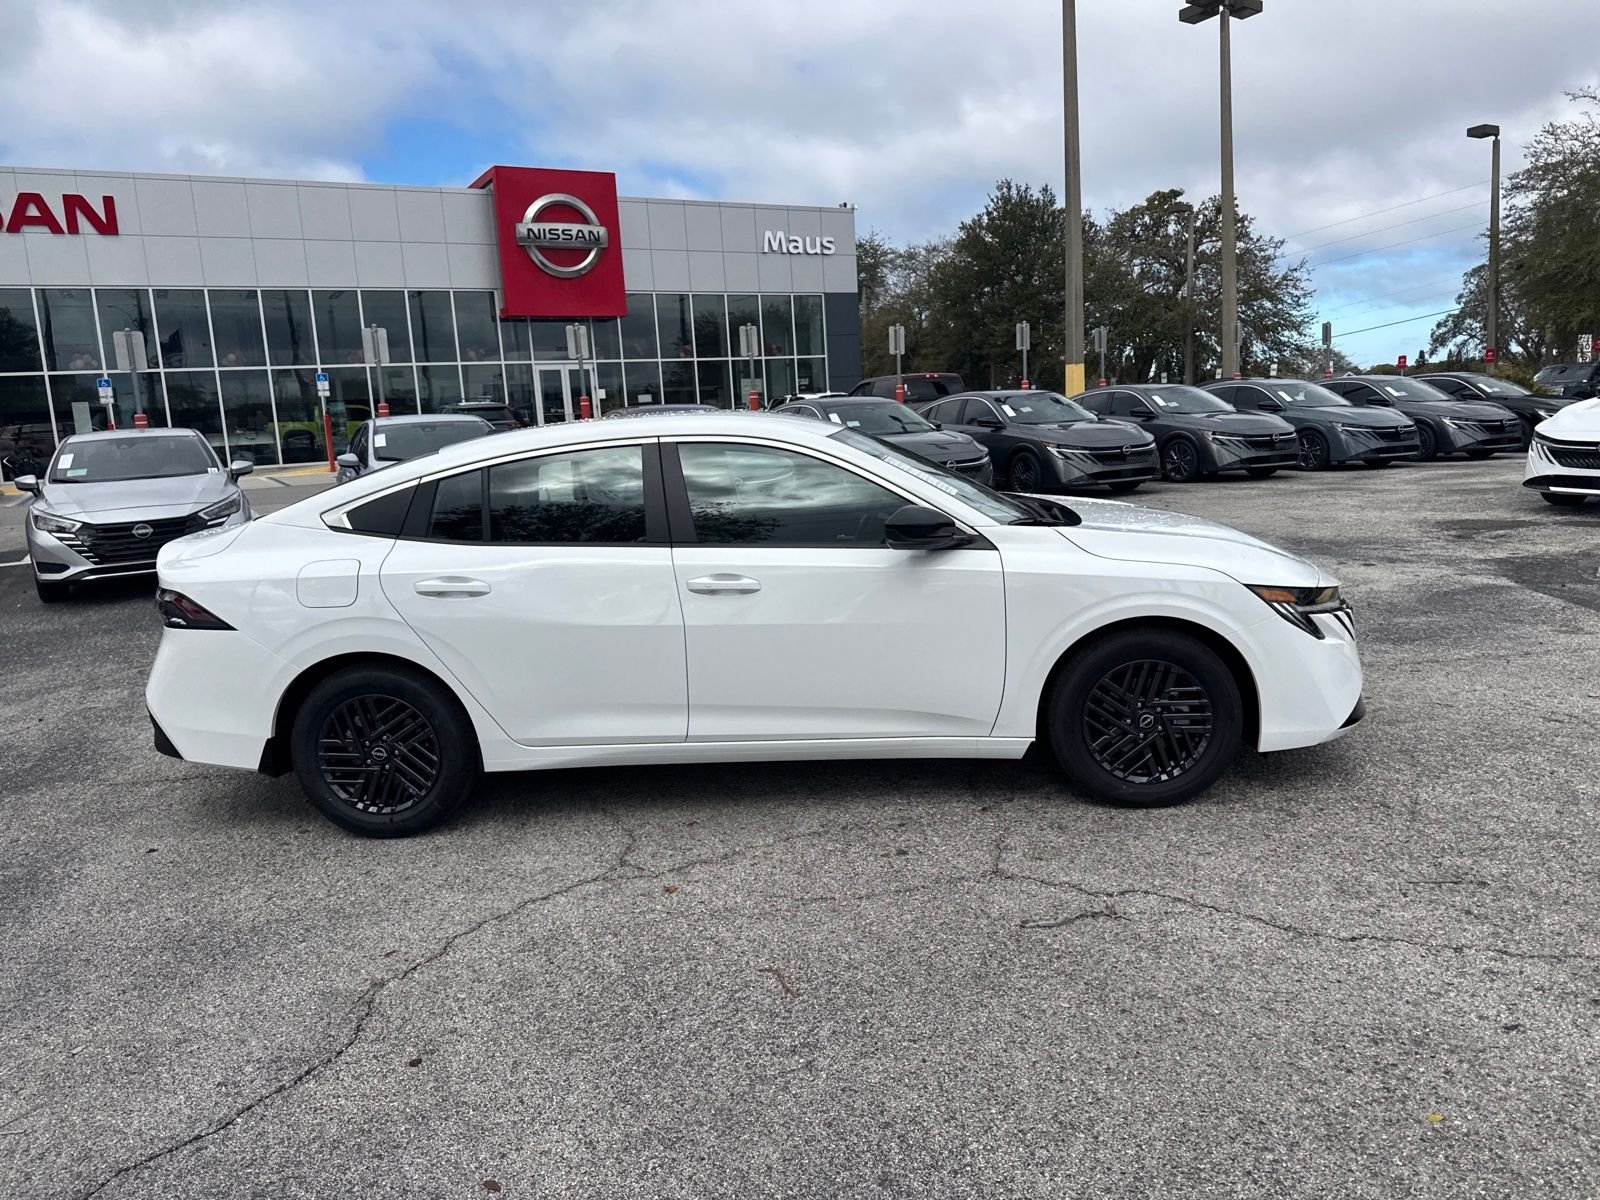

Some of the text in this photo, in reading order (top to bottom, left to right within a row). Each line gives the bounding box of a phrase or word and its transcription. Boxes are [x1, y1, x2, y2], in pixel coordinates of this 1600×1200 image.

[0, 192, 119, 236] AN
[526, 227, 601, 242] NISSAN
[763, 230, 836, 255] Maus
